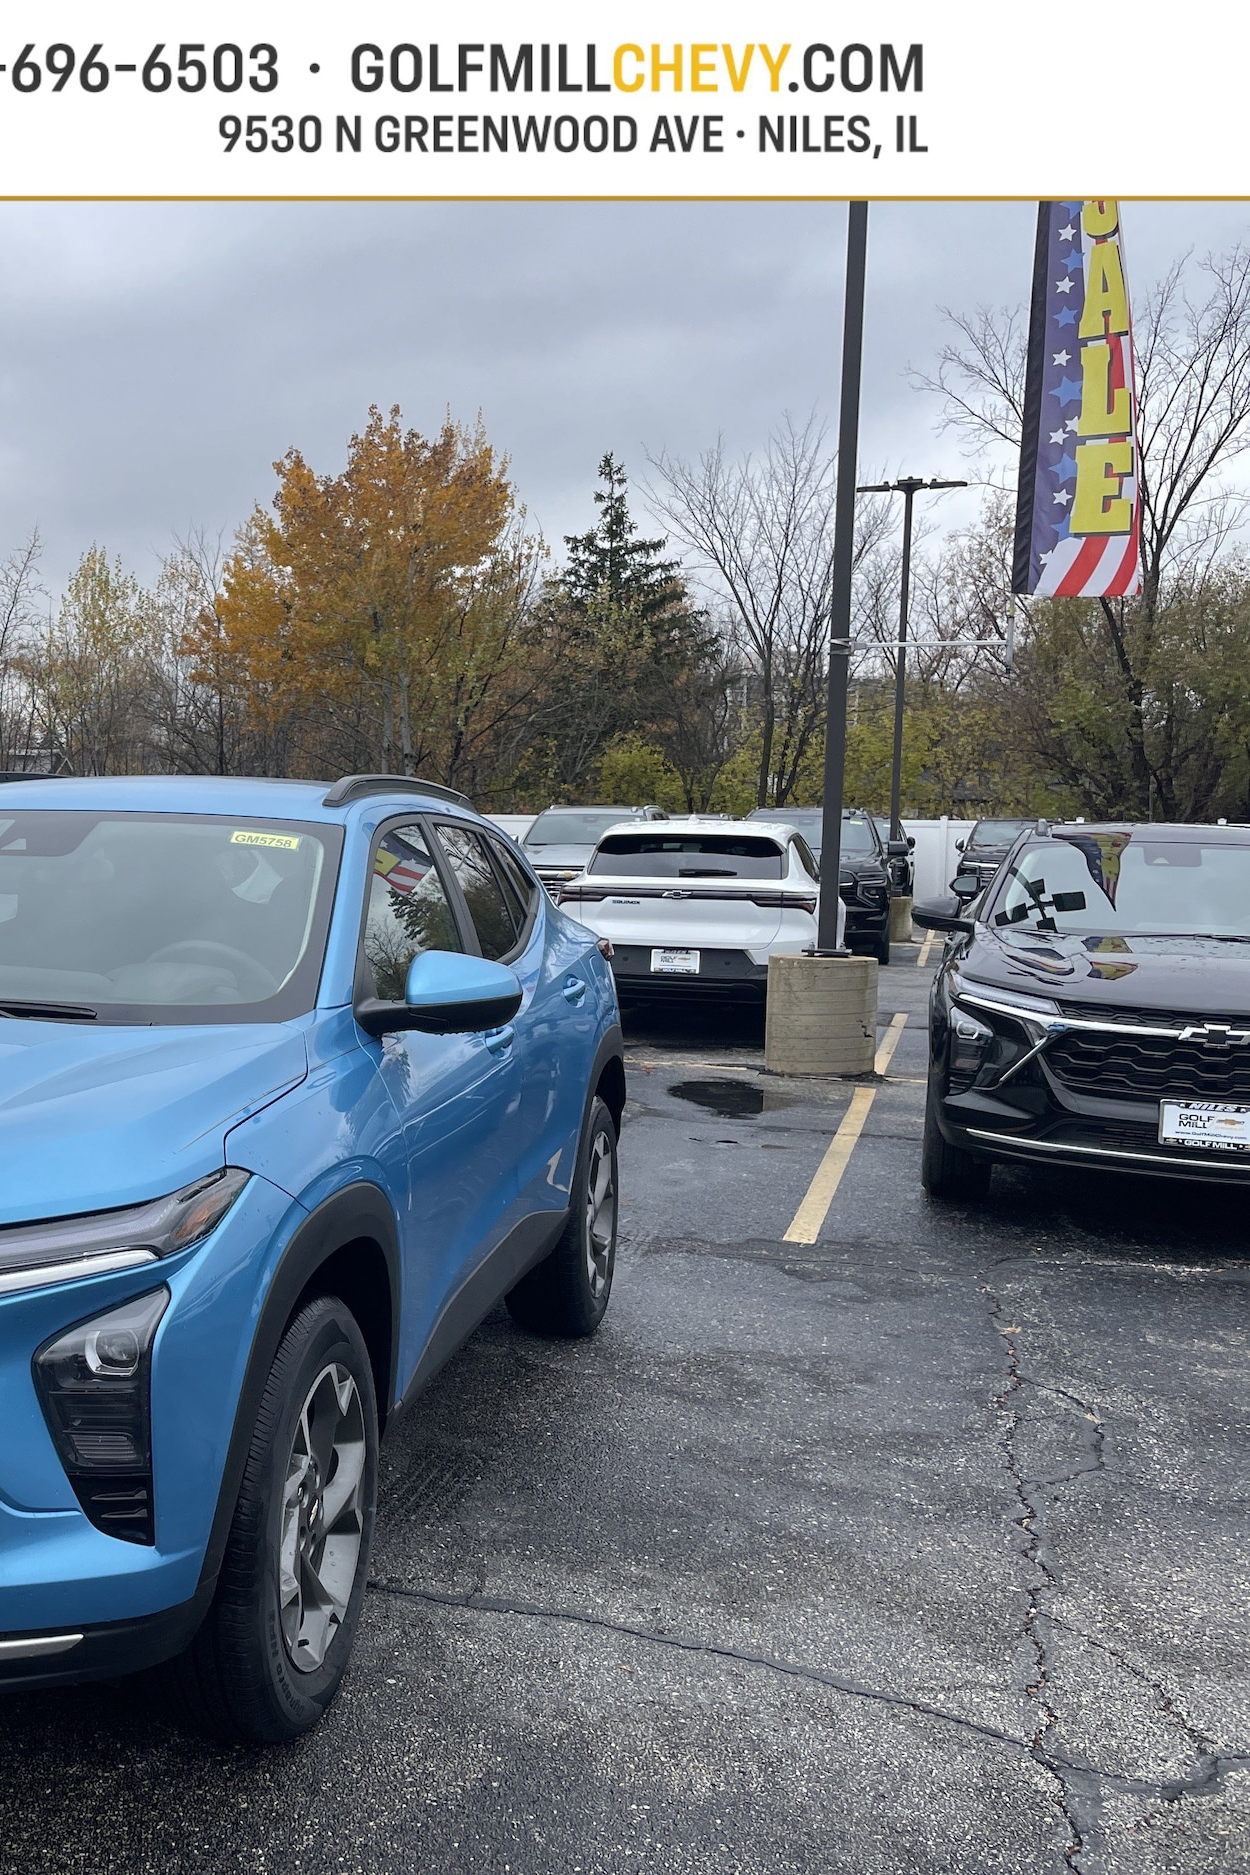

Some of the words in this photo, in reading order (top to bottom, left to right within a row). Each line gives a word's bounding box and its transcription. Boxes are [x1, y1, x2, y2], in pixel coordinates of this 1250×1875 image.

[235, 834, 293, 848] GM5758
[1188, 1103, 1238, 1112] NILES
[1178, 1113, 1215, 1123] GOLF
[1178, 1120, 1208, 1129] MILL
[1184, 1139, 1212, 1148] GOLF
[1212, 1142, 1238, 1151] MILL
